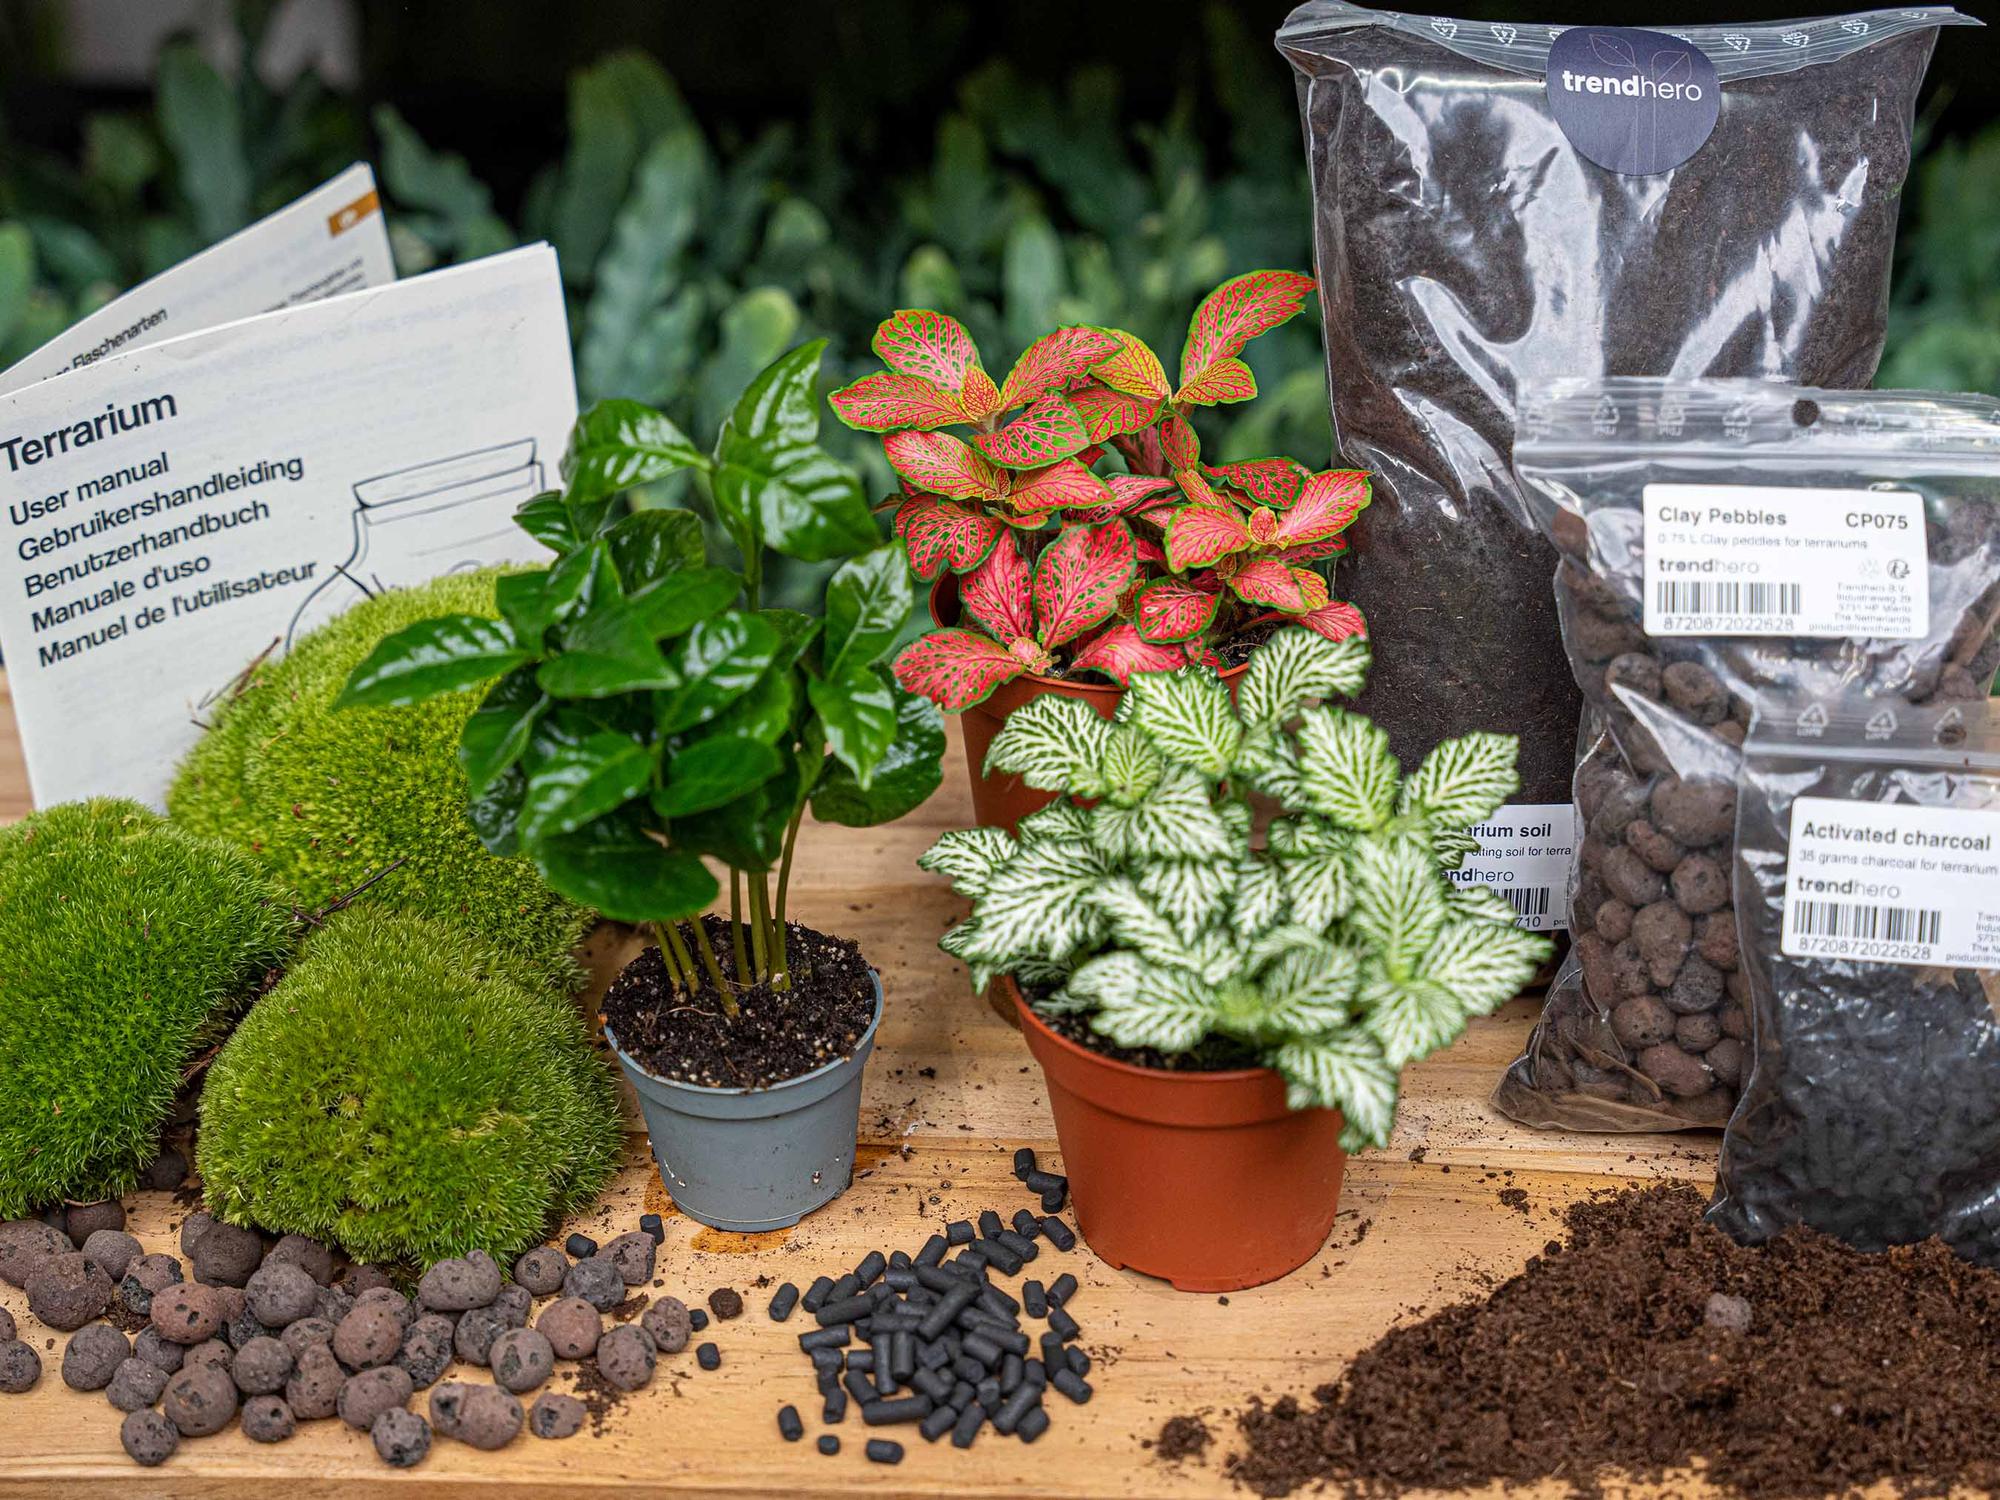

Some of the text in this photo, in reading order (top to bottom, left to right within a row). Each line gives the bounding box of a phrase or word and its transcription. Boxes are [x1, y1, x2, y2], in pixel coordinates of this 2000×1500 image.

[1562, 70, 1703, 102] trendhero
[0, 393, 178, 472] Terrarium
[9, 452, 170, 526] User manual
[18, 457, 305, 562] Gebruikershandleiding
[1658, 506, 1788, 526] Clay Pebbles
[1845, 512, 1909, 529] CP075
[24, 501, 270, 598] Benutzerhandbuch
[1701, 534, 1728, 548] Clay
[1785, 536, 1801, 548] for
[1804, 538, 1869, 550] terrariums
[1658, 558, 1761, 575] trendhero
[31, 556, 211, 633] Manuale d'uso
[38, 561, 317, 667] Manuel de l'utilisateur
[1519, 823, 1552, 838] soil
[1802, 822, 1992, 852] Activated charcoal
[1505, 847, 1525, 857] soil
[1528, 846, 1543, 857] for
[1818, 852, 1857, 867] grams
[1861, 854, 1917, 870] charcoal
[1920, 856, 1937, 872] for
[1797, 877, 1901, 900] trendhero
